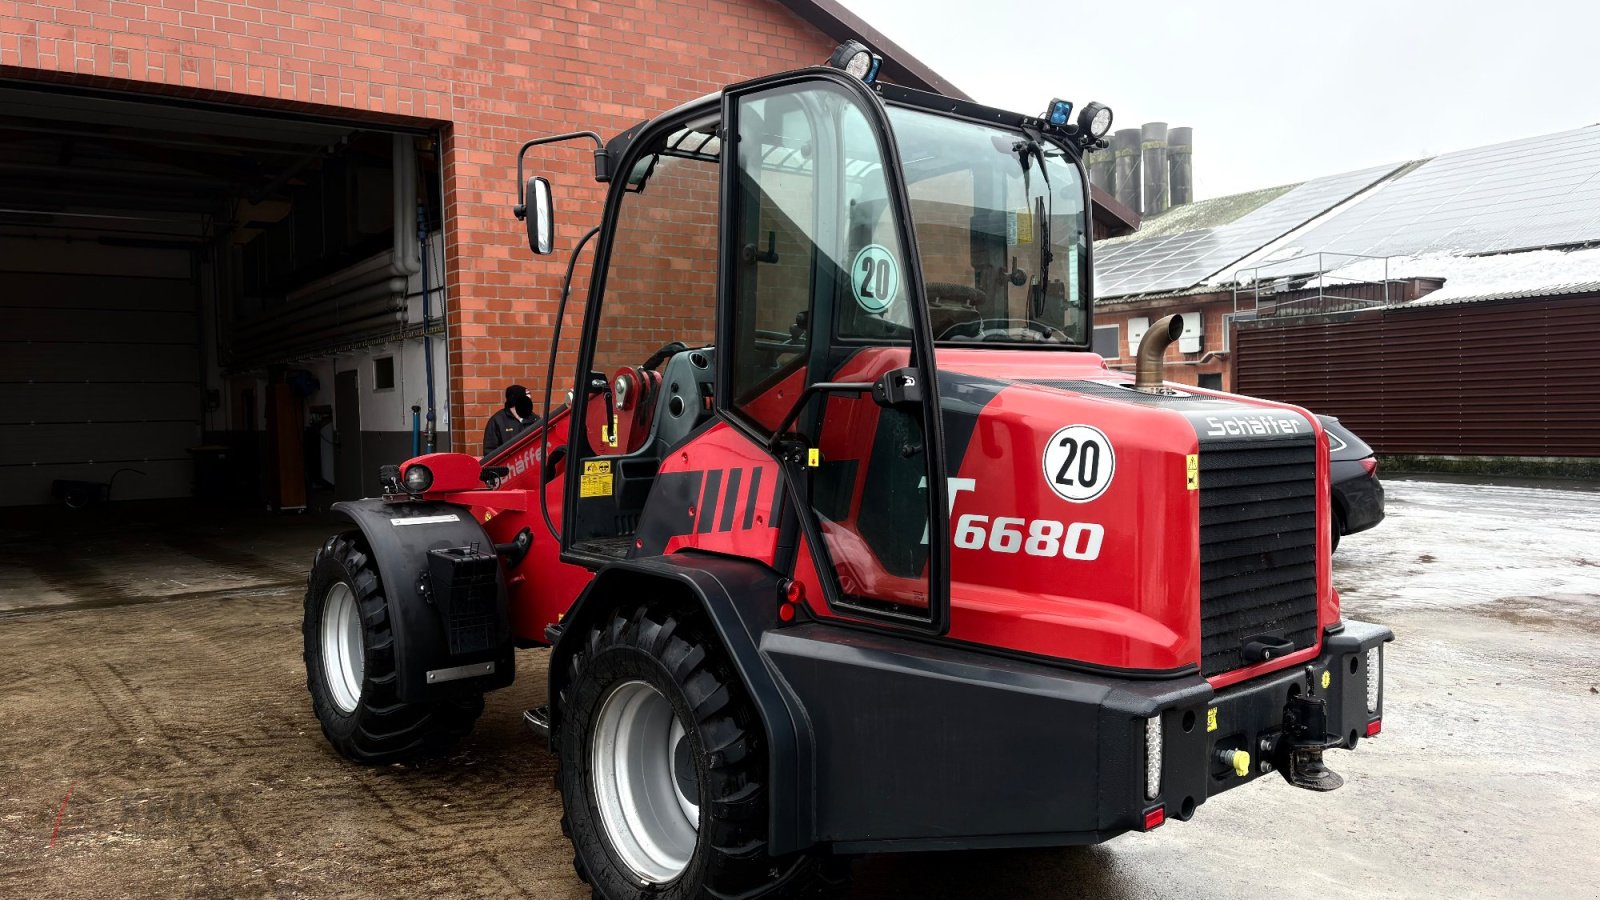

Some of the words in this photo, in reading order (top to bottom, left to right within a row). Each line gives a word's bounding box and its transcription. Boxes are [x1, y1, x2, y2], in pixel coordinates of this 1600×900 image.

[861, 256, 890, 300] 20
[1205, 416, 1300, 436] Schäffer
[1055, 437, 1100, 488] 20
